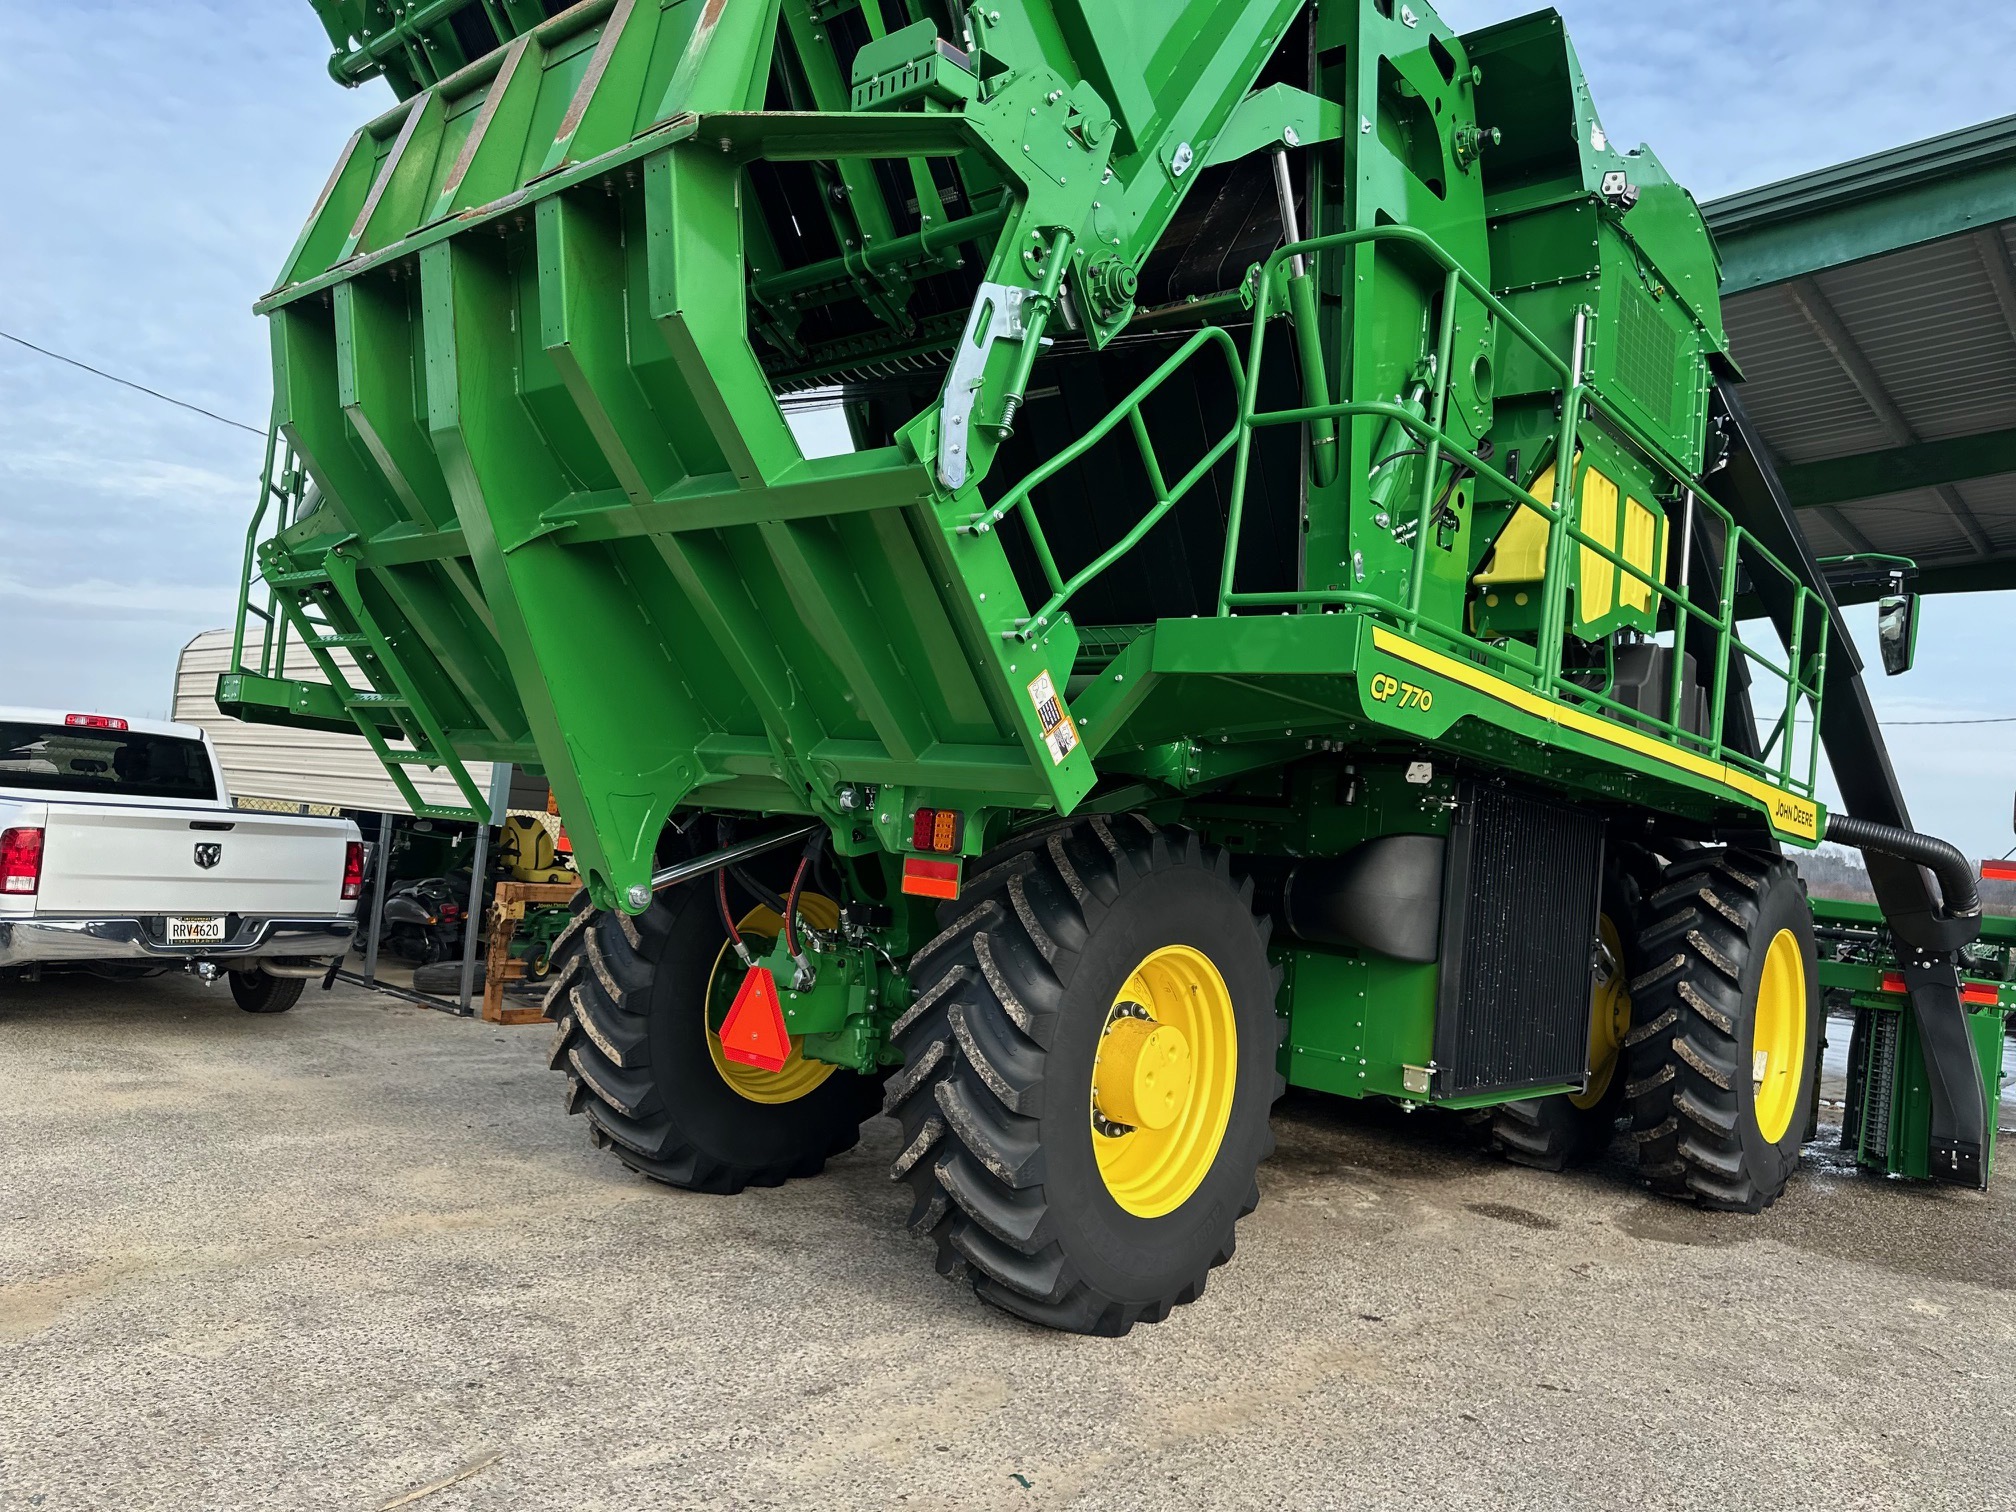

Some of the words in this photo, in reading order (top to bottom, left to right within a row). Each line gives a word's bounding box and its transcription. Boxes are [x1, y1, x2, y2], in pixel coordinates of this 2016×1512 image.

[1370, 672, 1398, 702] CP
[1396, 681, 1433, 712] 770
[1776, 799, 1793, 820] JOHN
[1794, 806, 1813, 827] DEERE
[173, 924, 218, 937] RRV4620
